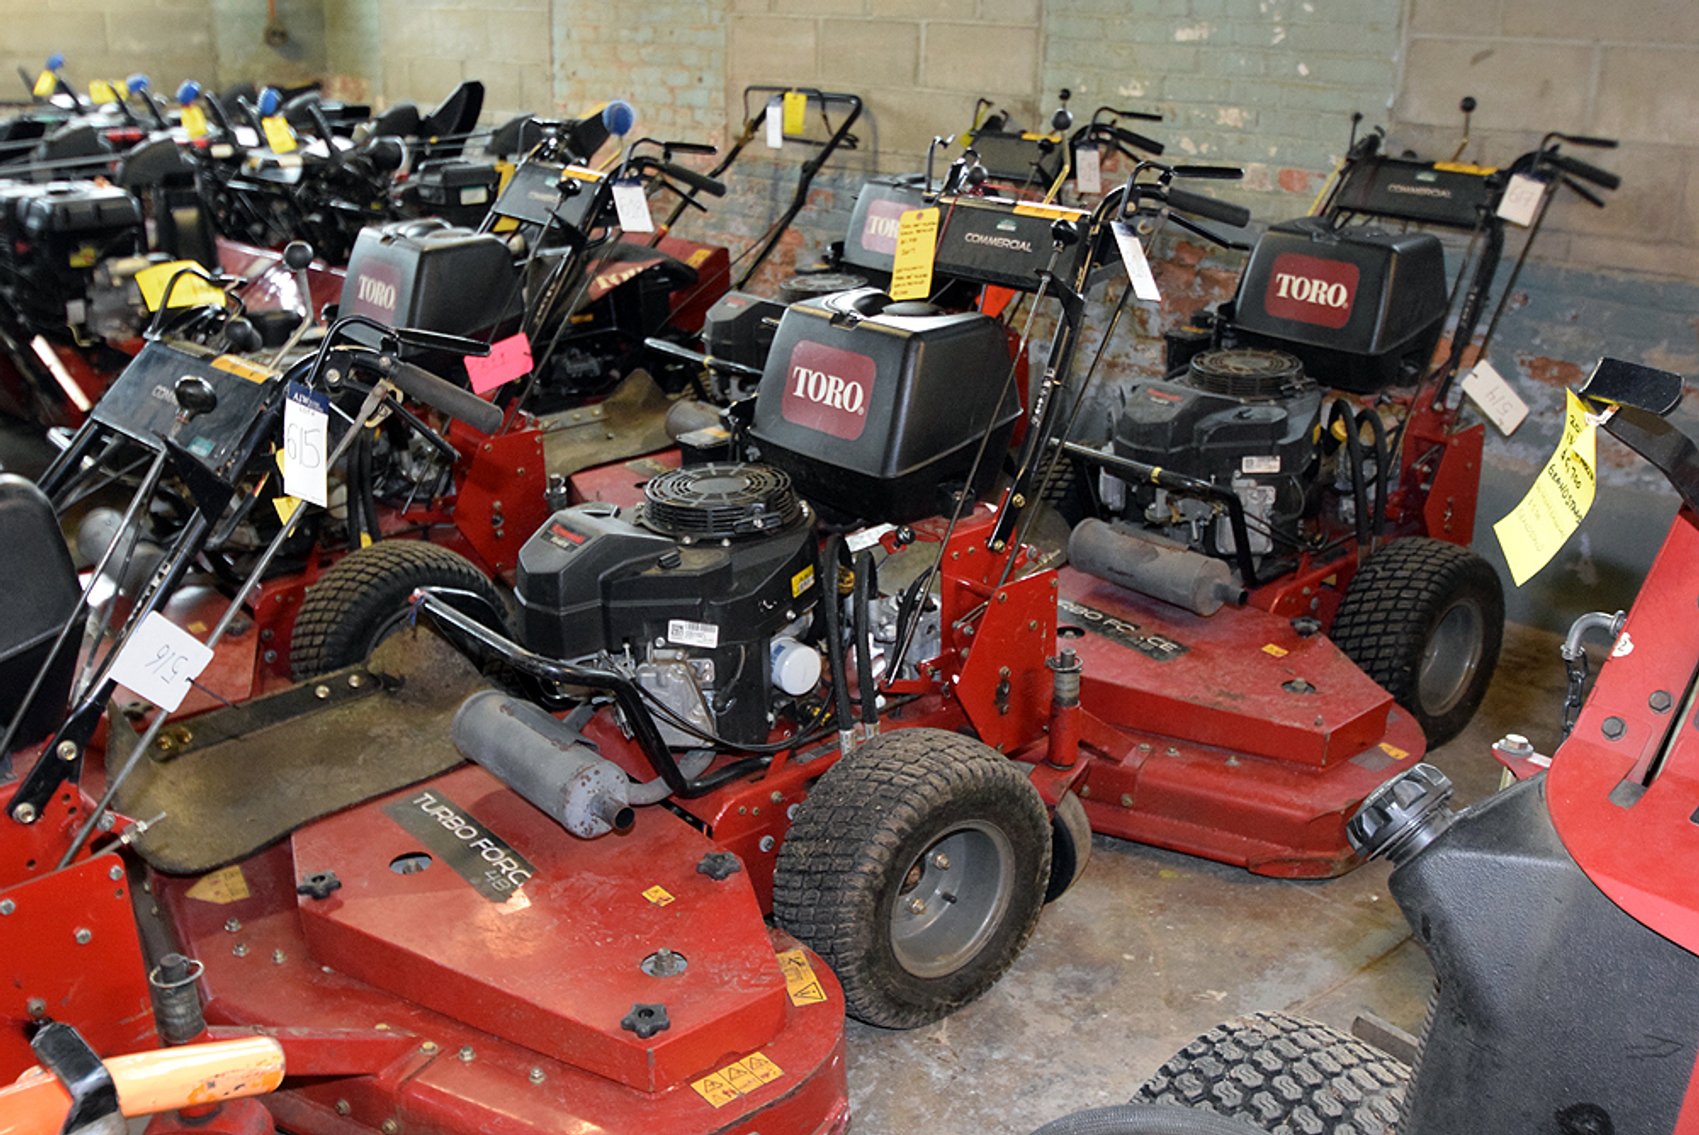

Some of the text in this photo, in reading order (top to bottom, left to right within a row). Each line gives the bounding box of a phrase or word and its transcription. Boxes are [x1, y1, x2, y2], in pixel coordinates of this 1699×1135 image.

[867, 215, 899, 239] TOR
[965, 232, 1032, 253] COMMERCIAL
[357, 274, 396, 311] TORO
[1276, 272, 1348, 309] TORO
[792, 365, 864, 415] TORO
[287, 422, 321, 469] 615
[413, 791, 533, 888] TURBO FORC
[484, 869, 511, 892] 48
